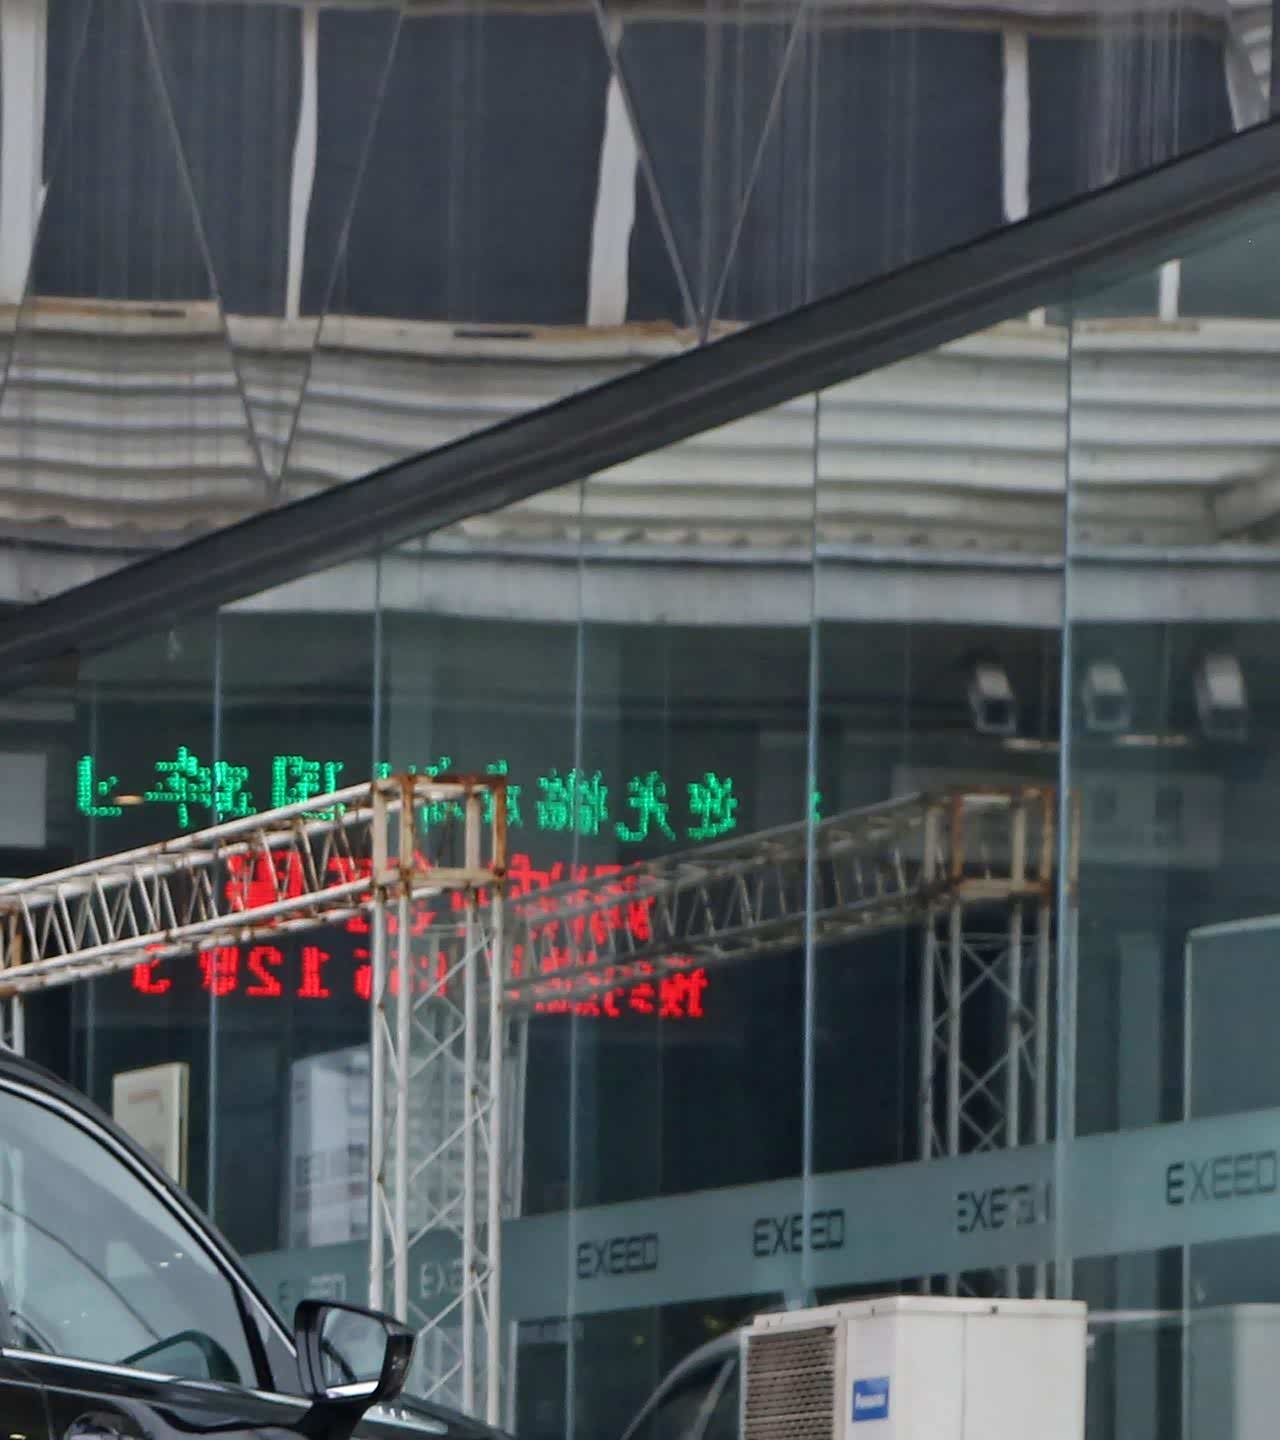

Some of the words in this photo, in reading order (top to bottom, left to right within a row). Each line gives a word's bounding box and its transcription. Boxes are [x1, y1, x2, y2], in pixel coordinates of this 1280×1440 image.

[1166, 1150, 1278, 1206] EXEED
[577, 1232, 658, 1279] EXEED
[754, 1208, 845, 1257] EXEED
